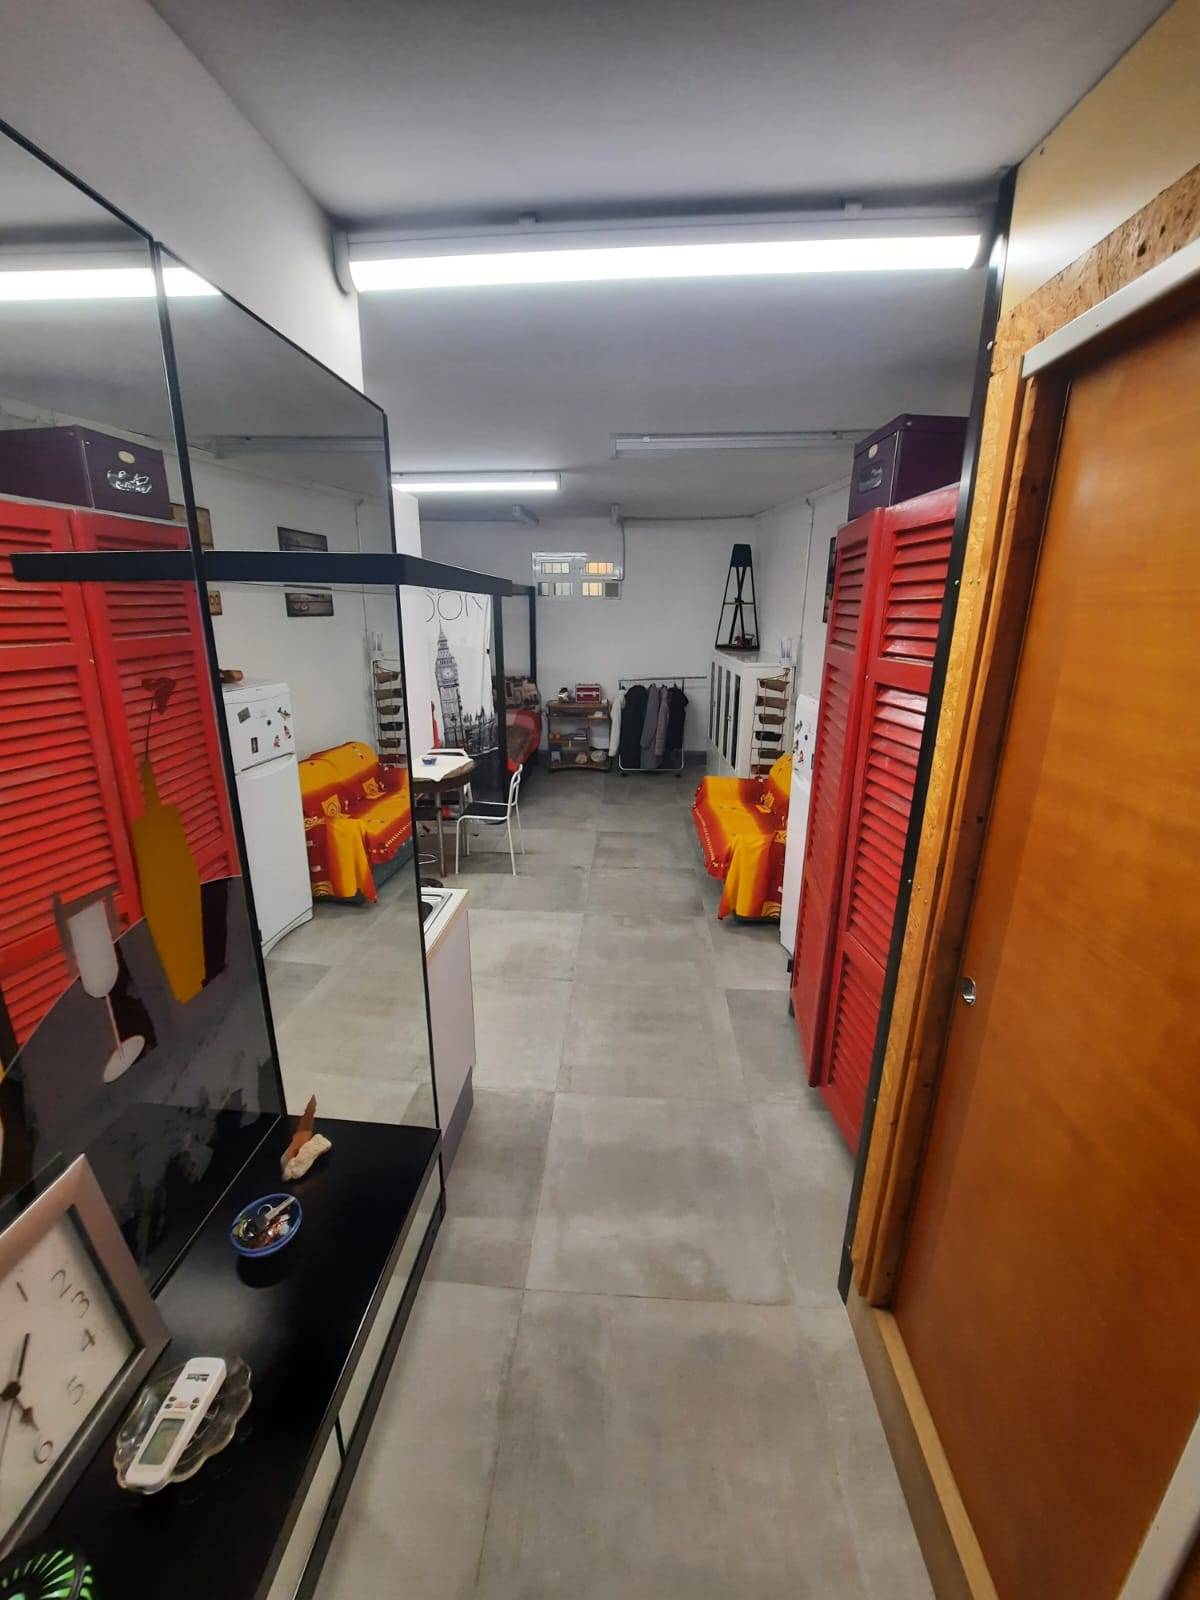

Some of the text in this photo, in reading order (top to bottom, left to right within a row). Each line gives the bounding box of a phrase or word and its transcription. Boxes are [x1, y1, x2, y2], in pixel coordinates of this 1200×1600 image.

[50, 1268, 73, 1299] 2
[71, 1290, 90, 1319] 3
[81, 1328, 96, 1352] 4
[66, 1376, 85, 1406] 5
